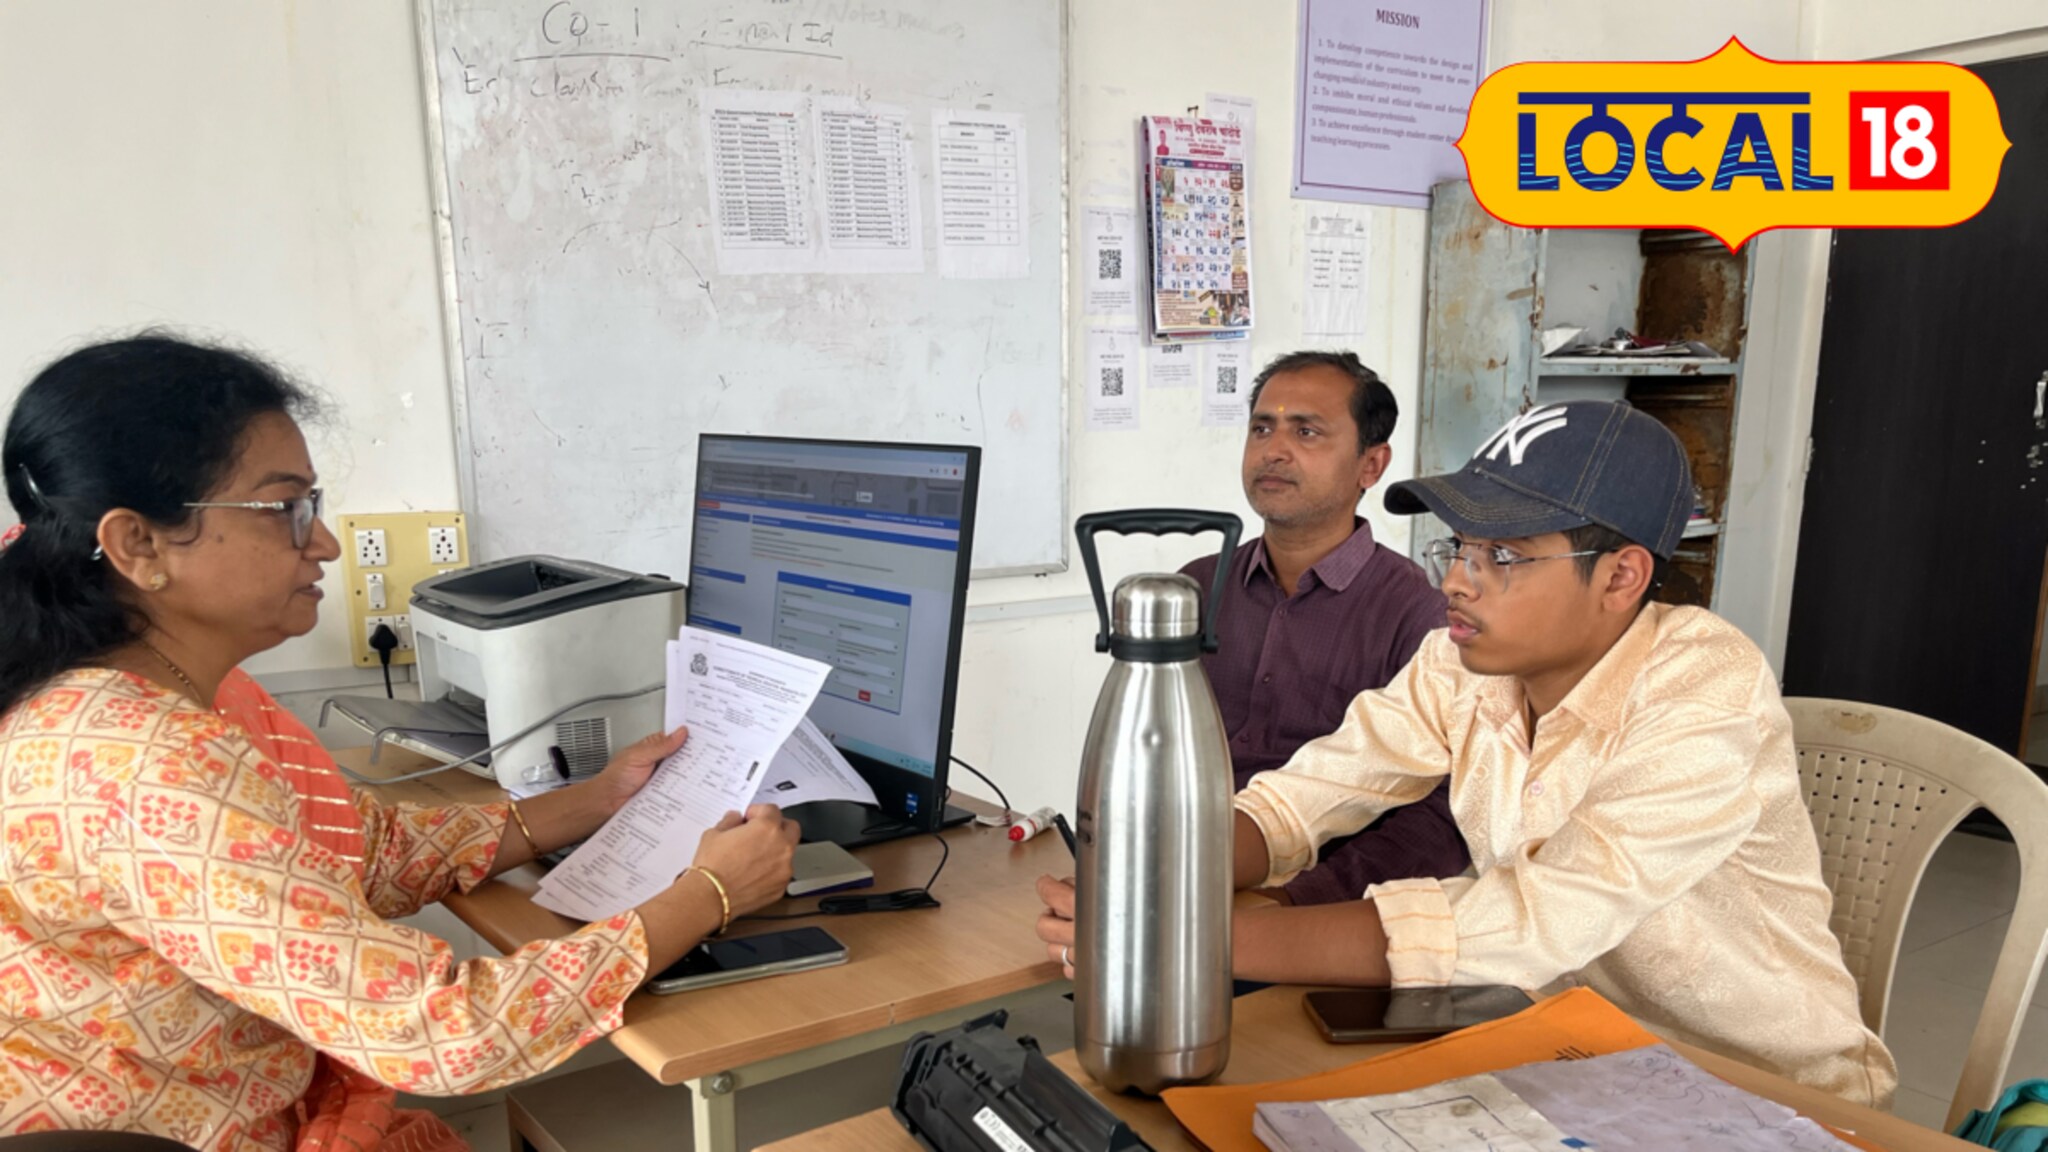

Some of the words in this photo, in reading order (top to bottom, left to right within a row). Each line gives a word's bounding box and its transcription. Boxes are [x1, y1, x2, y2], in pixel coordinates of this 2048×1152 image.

[1376, 8, 1420, 29] MISSION
[1327, 39, 1335, 48] To
[1337, 41, 1362, 54] develop
[1429, 56, 1439, 65] the
[1441, 58, 1460, 71] design
[1462, 63, 1474, 72] and
[1314, 54, 1363, 69] implementation
[1366, 62, 1373, 70] of
[1375, 64, 1385, 72] the
[1430, 74, 1444, 82] meet
[1446, 75, 1456, 83] the
[1313, 70, 1341, 84] changing
[1390, 82, 1402, 90] and
[1322, 86, 1330, 96] To
[1357, 93, 1375, 102] moral
[1378, 96, 1390, 104] and
[1392, 97, 1412, 108] ethical
[1435, 104, 1446, 112] and
[1318, 118, 1327, 128] To
[1328, 120, 1350, 130] achieve
[1352, 124, 1381, 134] excellence
[1382, 128, 1405, 138] through
[1310, 134, 1337, 147] teaching
